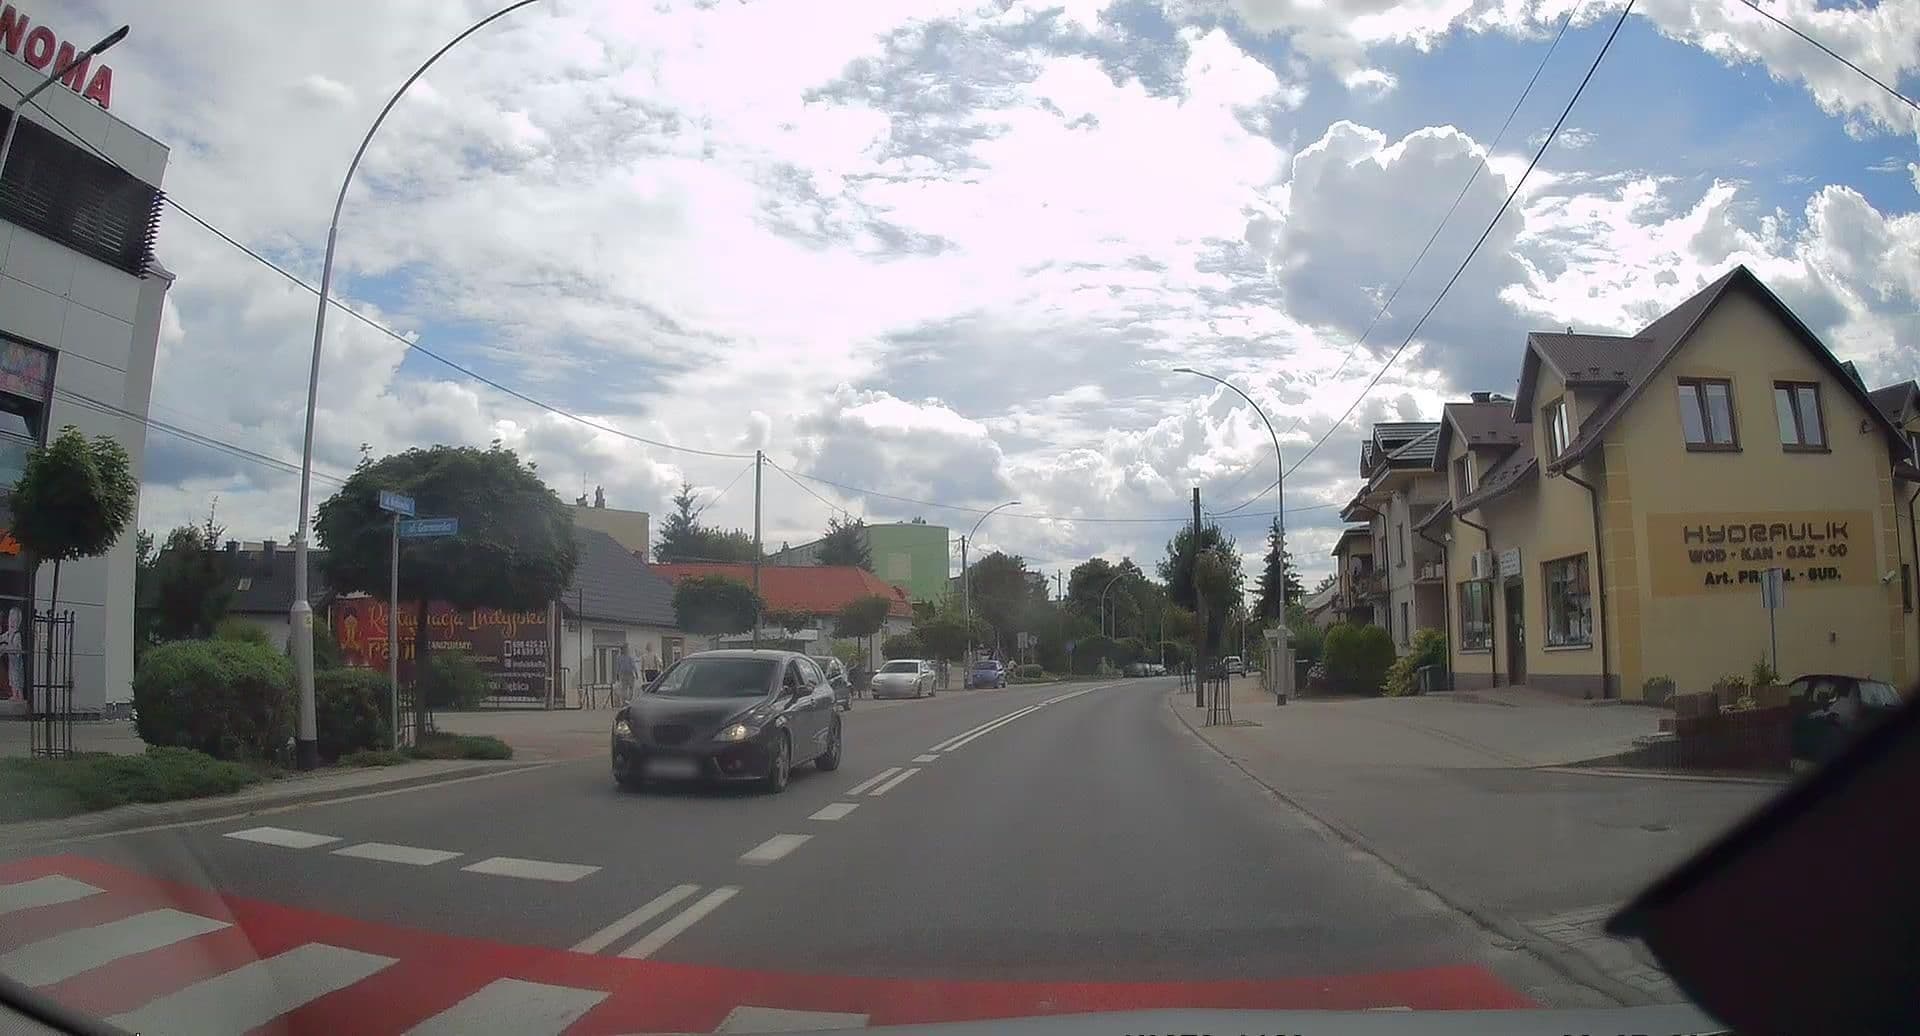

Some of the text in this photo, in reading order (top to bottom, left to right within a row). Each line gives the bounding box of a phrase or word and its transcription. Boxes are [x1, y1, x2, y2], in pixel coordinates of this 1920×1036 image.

[0, 3, 113, 110] NOMA
[1683, 521, 1849, 544] HYDRAULIK
[1688, 543, 1848, 563] WOD KAN GAZ CO
[1705, 566, 1842, 585] Art. PRM. BUD.
